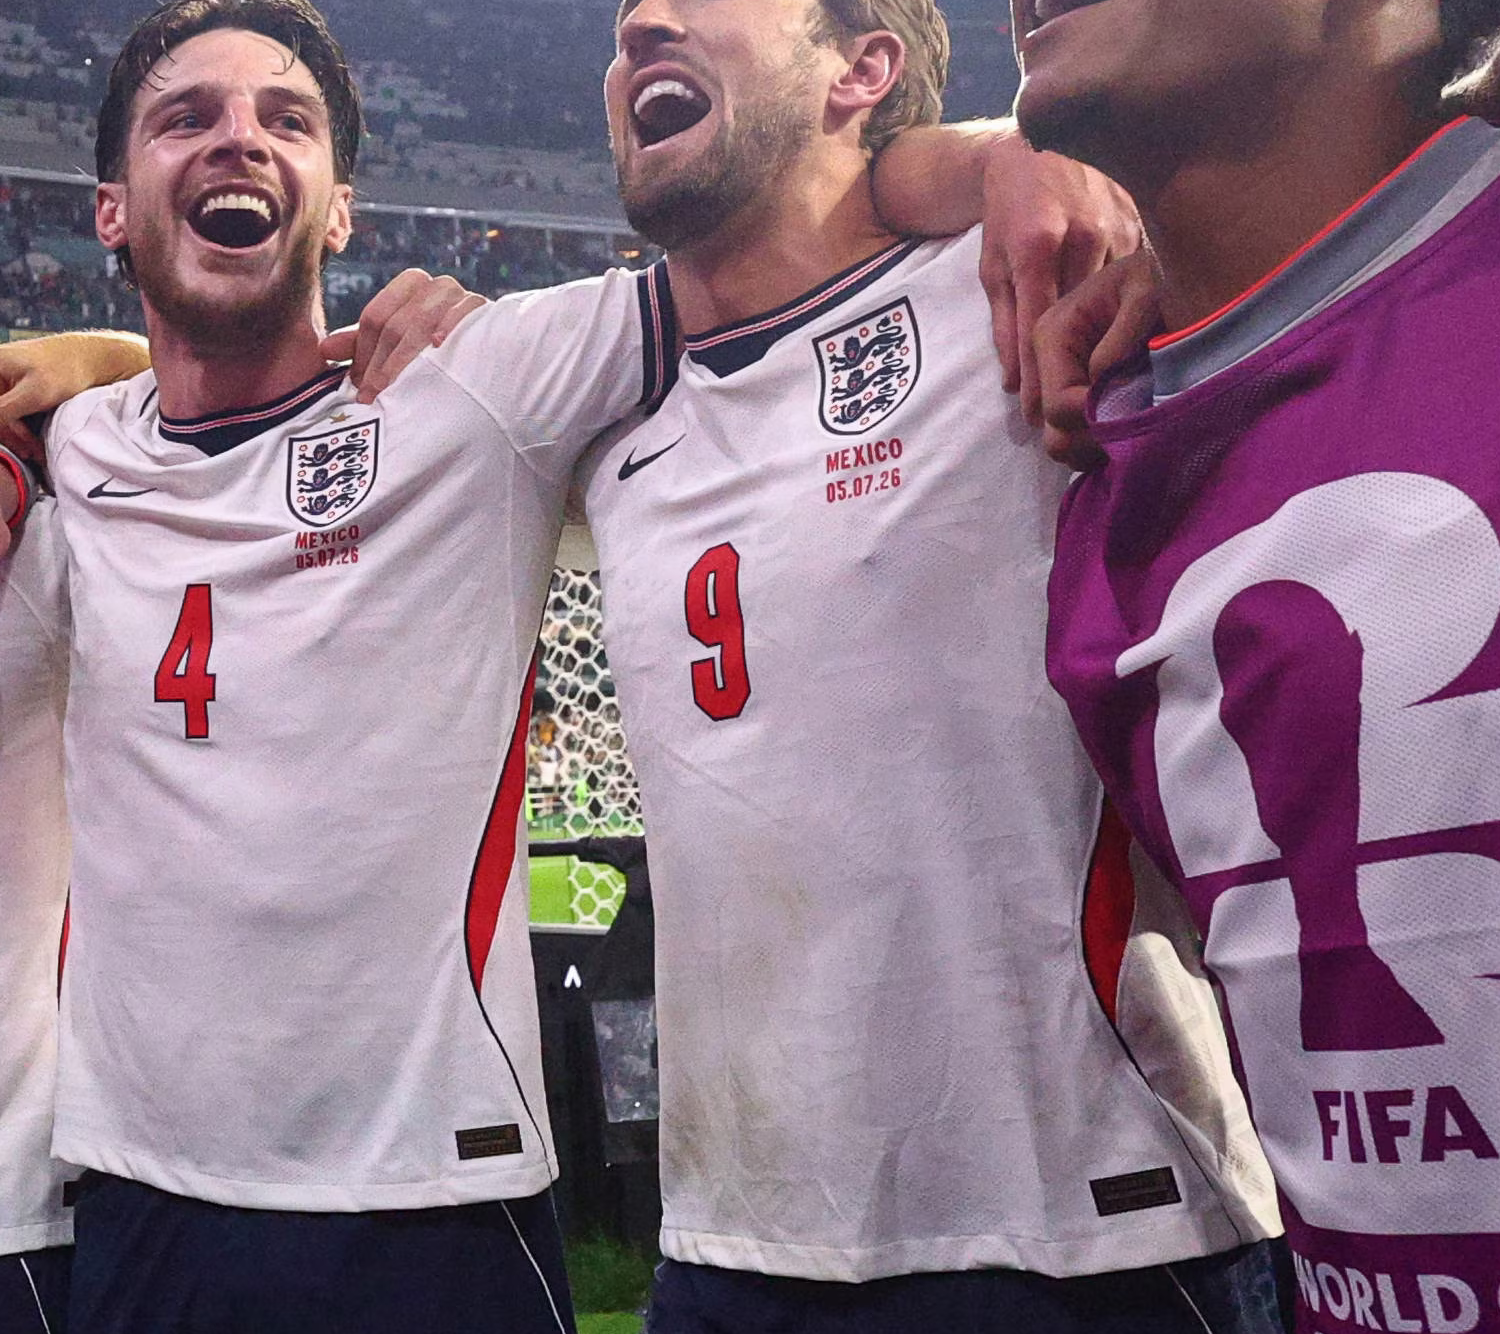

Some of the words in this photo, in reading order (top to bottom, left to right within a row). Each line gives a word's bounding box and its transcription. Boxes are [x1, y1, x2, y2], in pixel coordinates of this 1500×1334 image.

[826, 437, 904, 474] MEXICO
[826, 467, 902, 503] 05.07.26
[295, 525, 360, 549] MEXICO
[295, 546, 360, 569] 05.07.26
[684, 541, 751, 721] 9
[154, 583, 217, 740] 4
[1312, 1085, 1500, 1164] FIFA
[1292, 1250, 1481, 1334] WORLD
